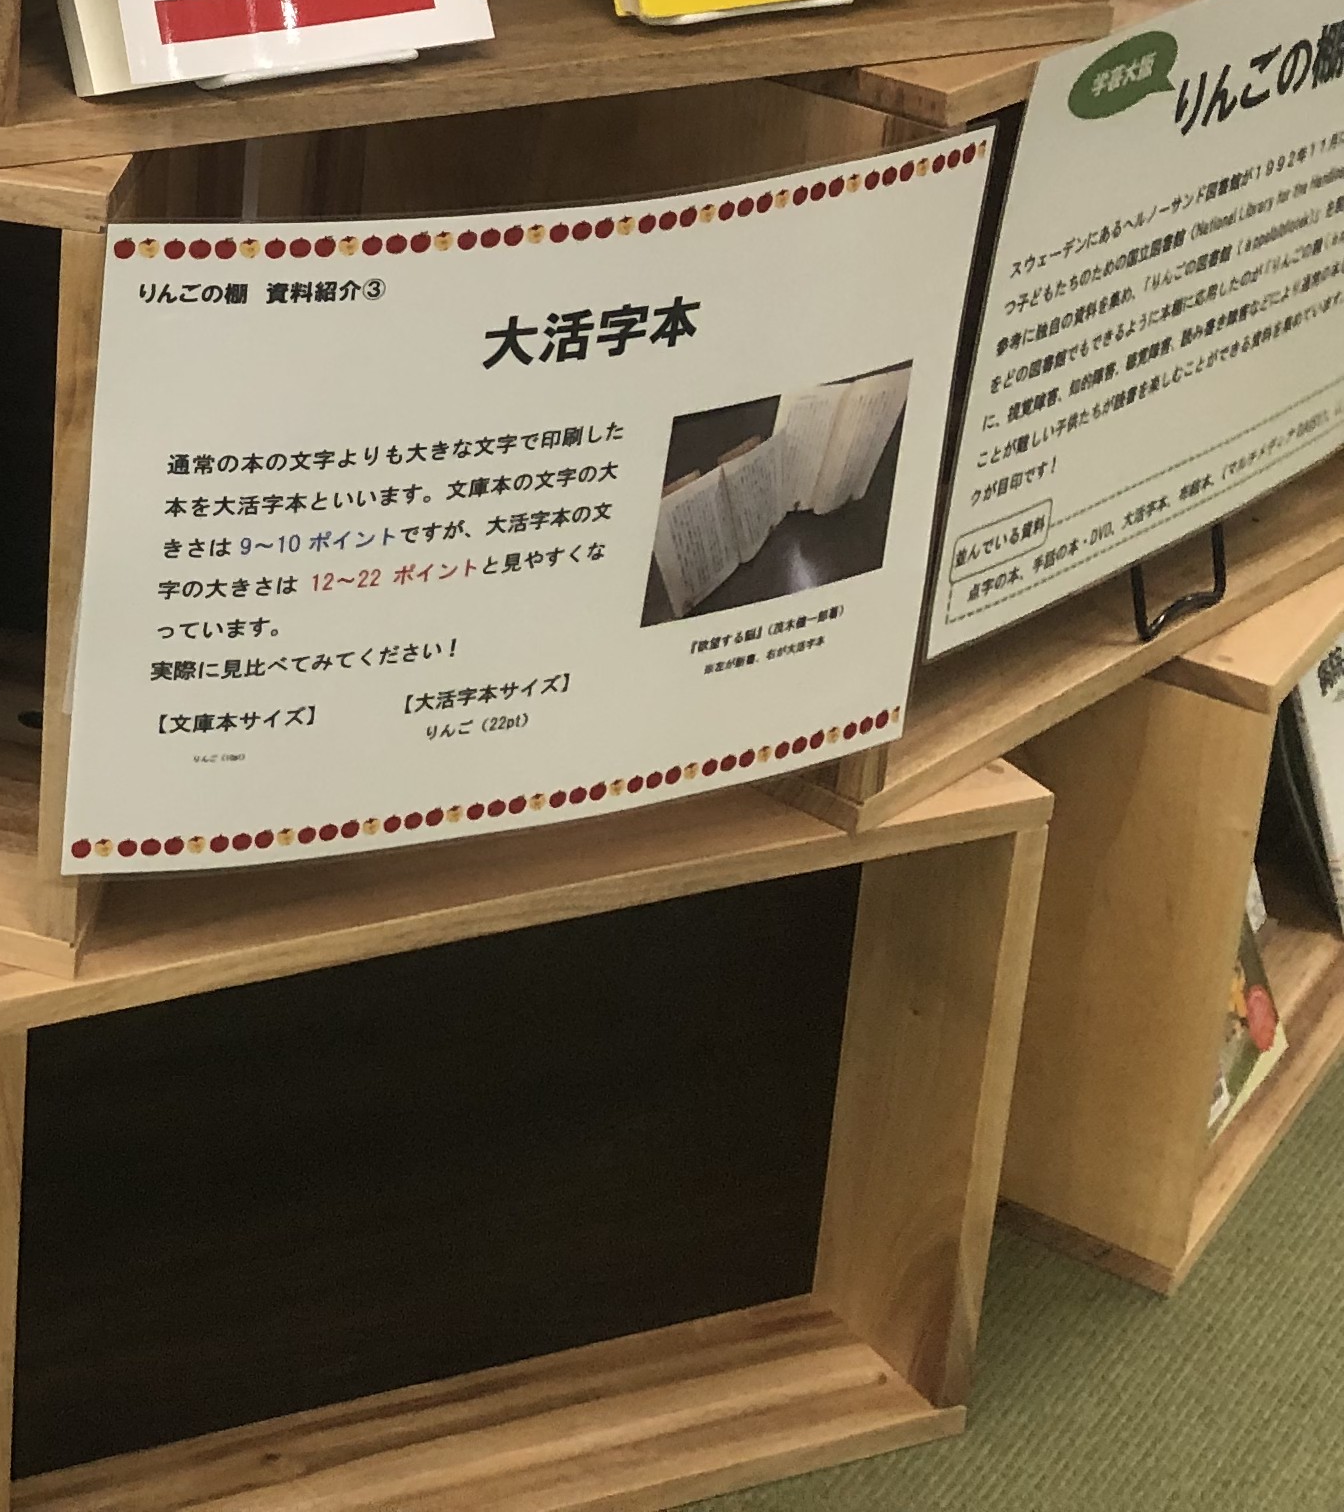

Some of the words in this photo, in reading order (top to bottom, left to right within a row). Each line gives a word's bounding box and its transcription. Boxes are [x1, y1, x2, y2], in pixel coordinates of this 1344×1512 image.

[139, 282, 248, 305] りんごの棚
[266, 278, 386, 305] 資料紹介③
[482, 295, 703, 370] 大活字本
[166, 420, 625, 476] 通常の本の文字よりも大きな文字で印刷した
[164, 461, 619, 518] 本を大活字本といいます。文庫本の文字の大
[971, 455, 1057, 508] クが目印です！
[163, 537, 232, 558] きさは
[308, 500, 613, 553] ポイントですが、大活字本の文
[955, 513, 1046, 569] 並んでいる資料
[157, 573, 299, 601] 字の大きさは
[393, 541, 606, 587] ポイントと見やすくな
[156, 615, 281, 640] っています。
[150, 638, 458, 682] 実際に見比べてみてください！
[158, 705, 317, 736] 【文庫本サイズ】
[404, 672, 571, 716] 【大活字本サイズ】
